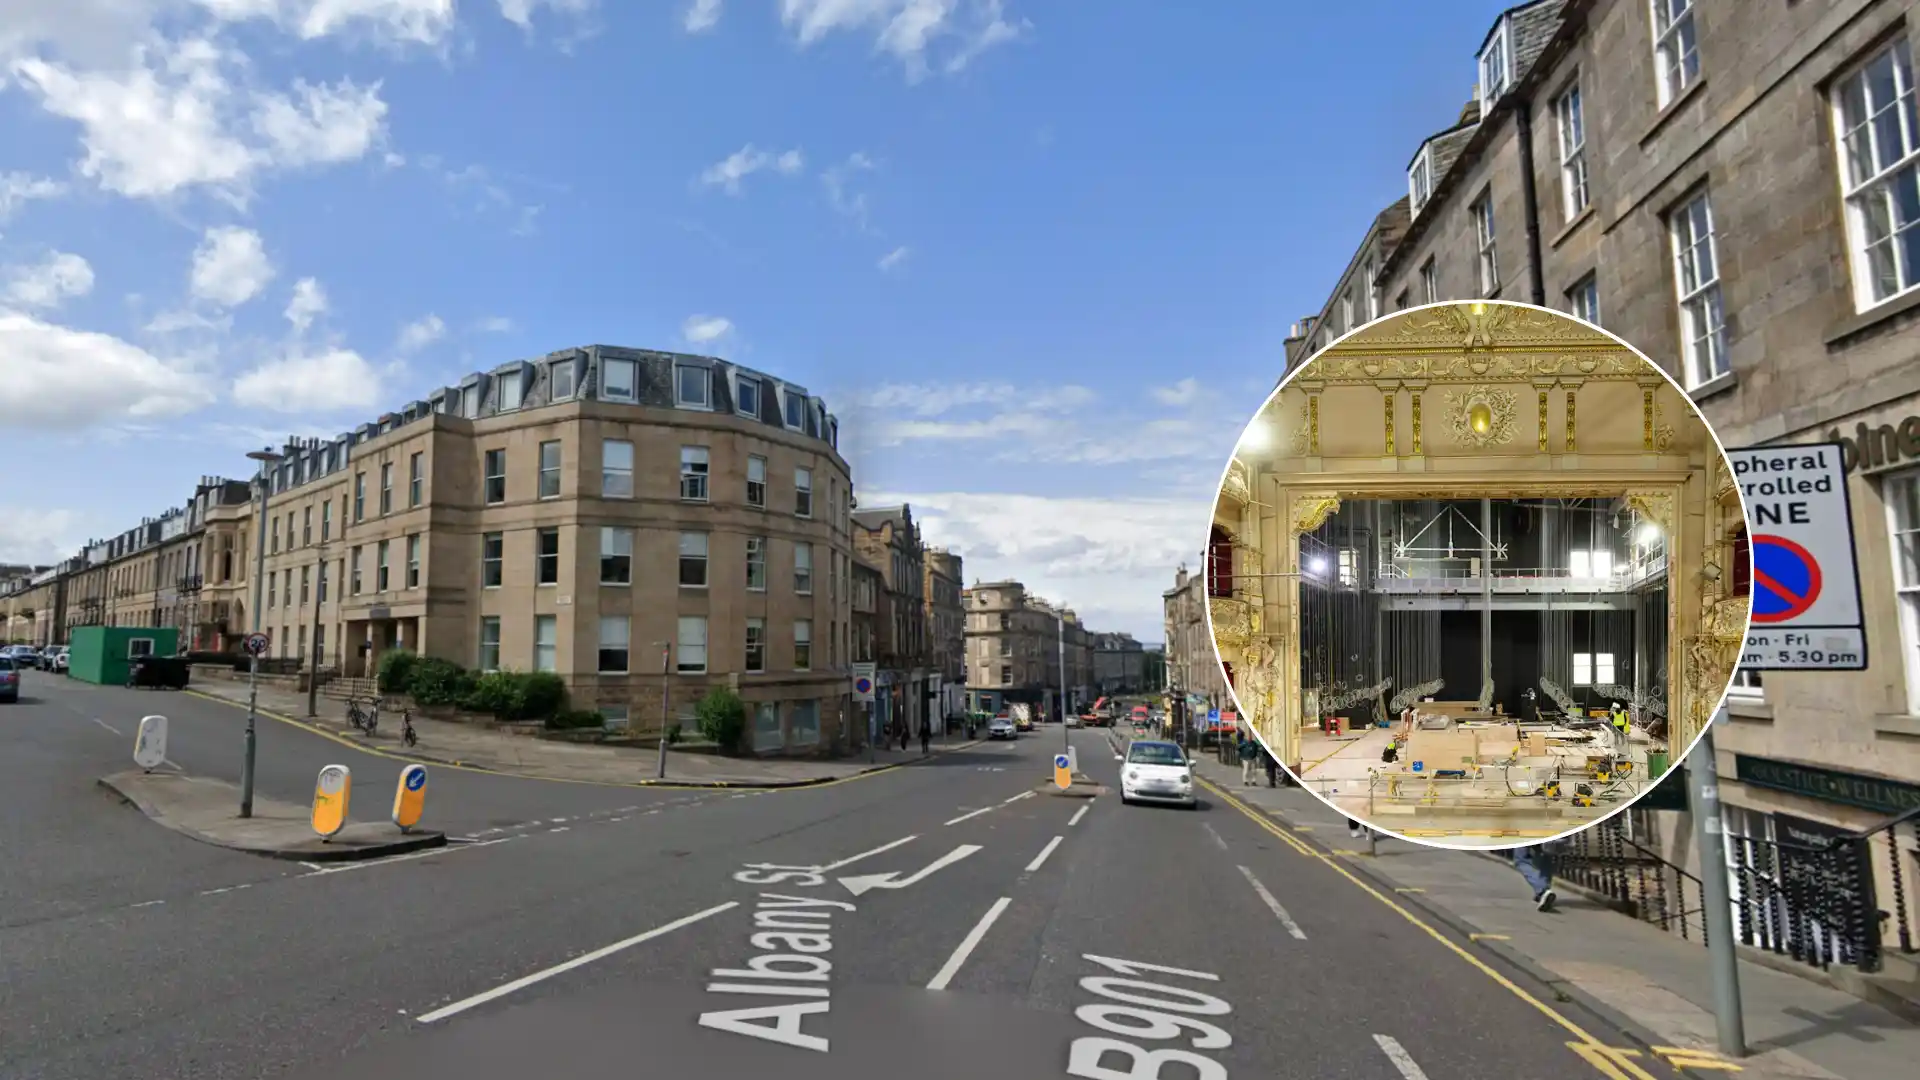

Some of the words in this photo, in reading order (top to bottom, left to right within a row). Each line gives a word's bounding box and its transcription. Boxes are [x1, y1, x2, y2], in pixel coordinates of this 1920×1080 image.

[1748, 502, 1810, 525] NE
[251, 639, 265, 648] 20
[1785, 634, 1810, 646] Fri
[1778, 650, 1823, 663] 5.30
[1828, 653, 1857, 664] pm
[731, 862, 828, 887] St
[698, 892, 857, 1053] Albany
[1066, 953, 1233, 1080] B901
